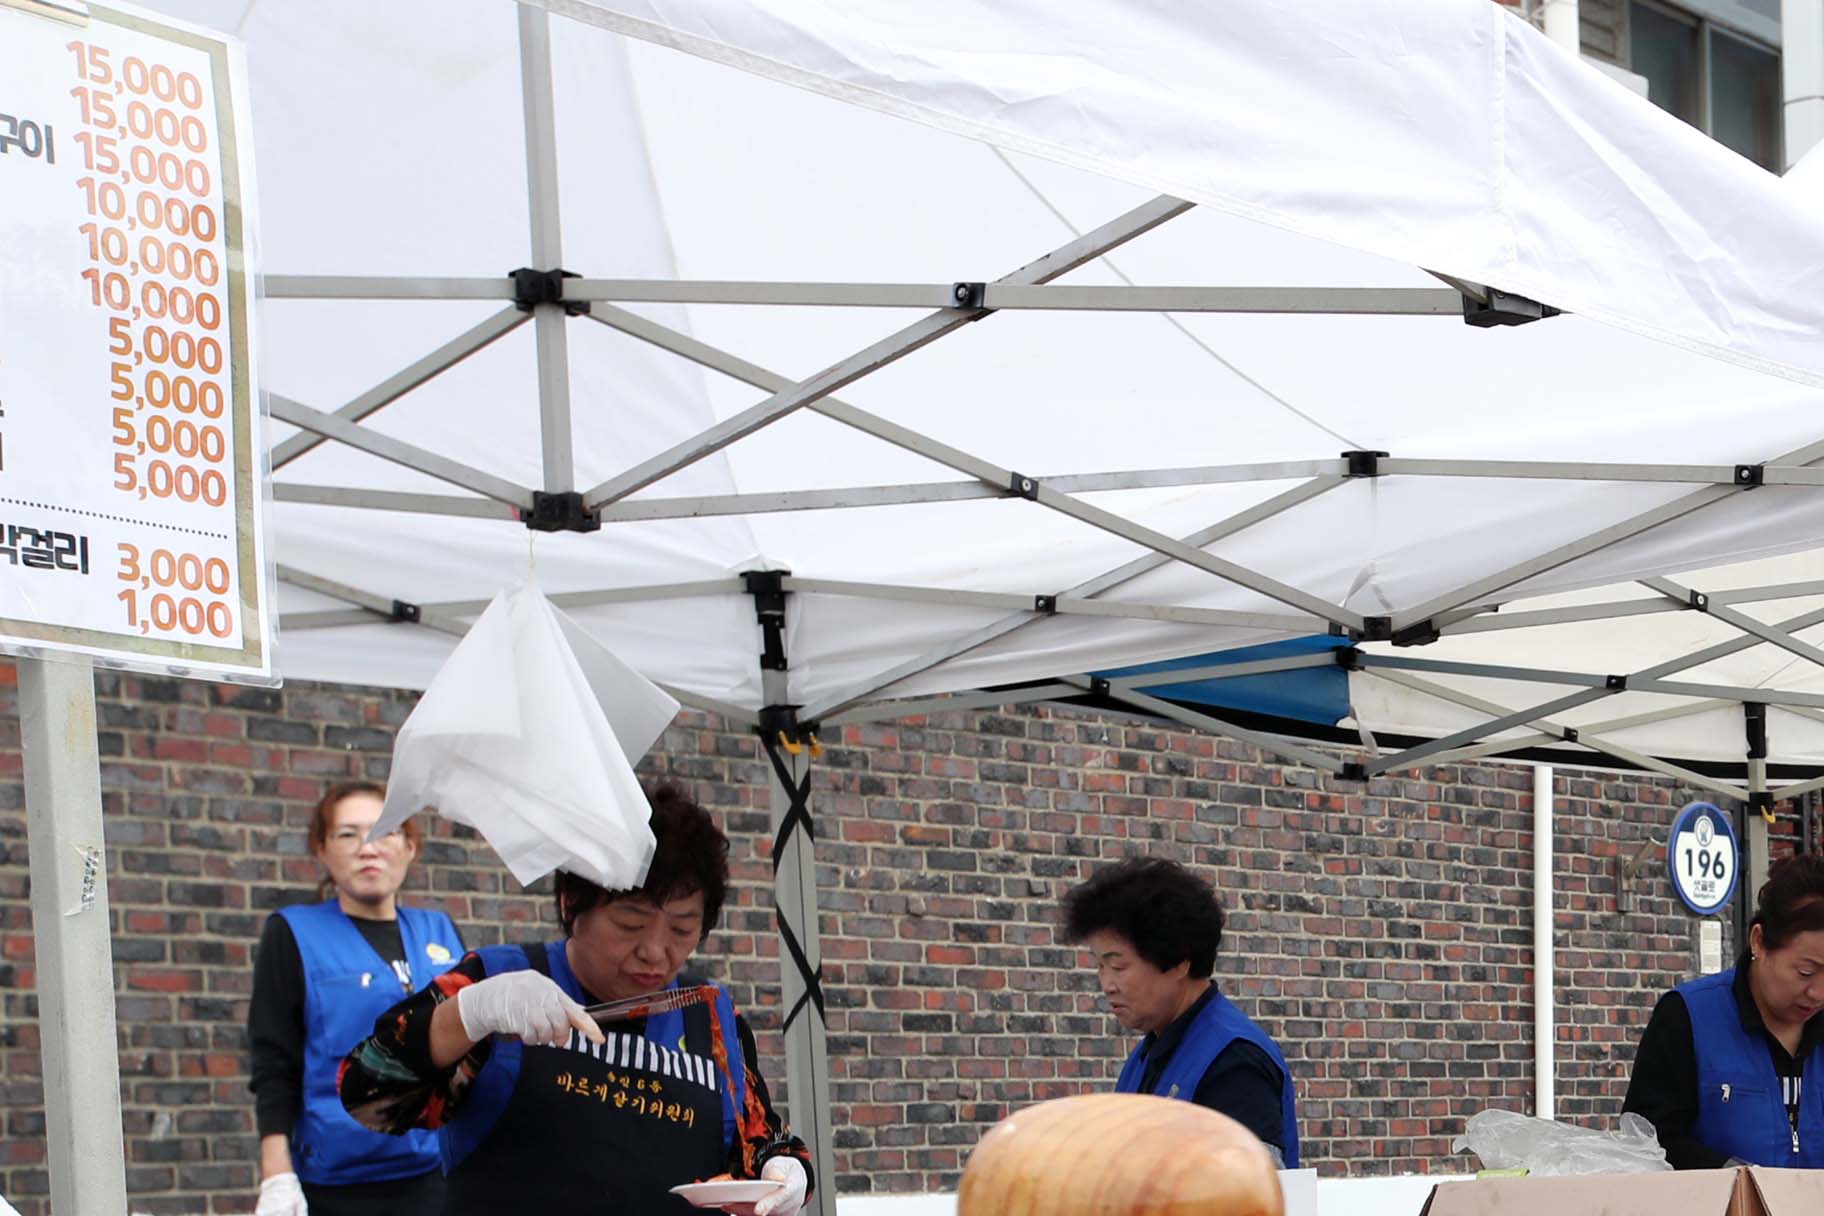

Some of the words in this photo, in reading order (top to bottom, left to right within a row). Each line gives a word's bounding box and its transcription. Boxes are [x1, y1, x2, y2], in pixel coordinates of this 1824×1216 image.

[66, 41, 202, 110] 15,000
[70, 86, 207, 153] 15,000
[73, 132, 211, 198] 15,000
[76, 176, 216, 243] 10,000
[79, 222, 220, 287] 10,000
[81, 268, 221, 331] 10,000
[109, 317, 223, 375] 5,000
[111, 362, 224, 419] 5,000
[113, 407, 225, 463] 5,000
[114, 452, 227, 507] 5,000
[117, 543, 230, 595] 3,000
[117, 588, 233, 638] 1,000
[1685, 848, 1725, 879] 196
